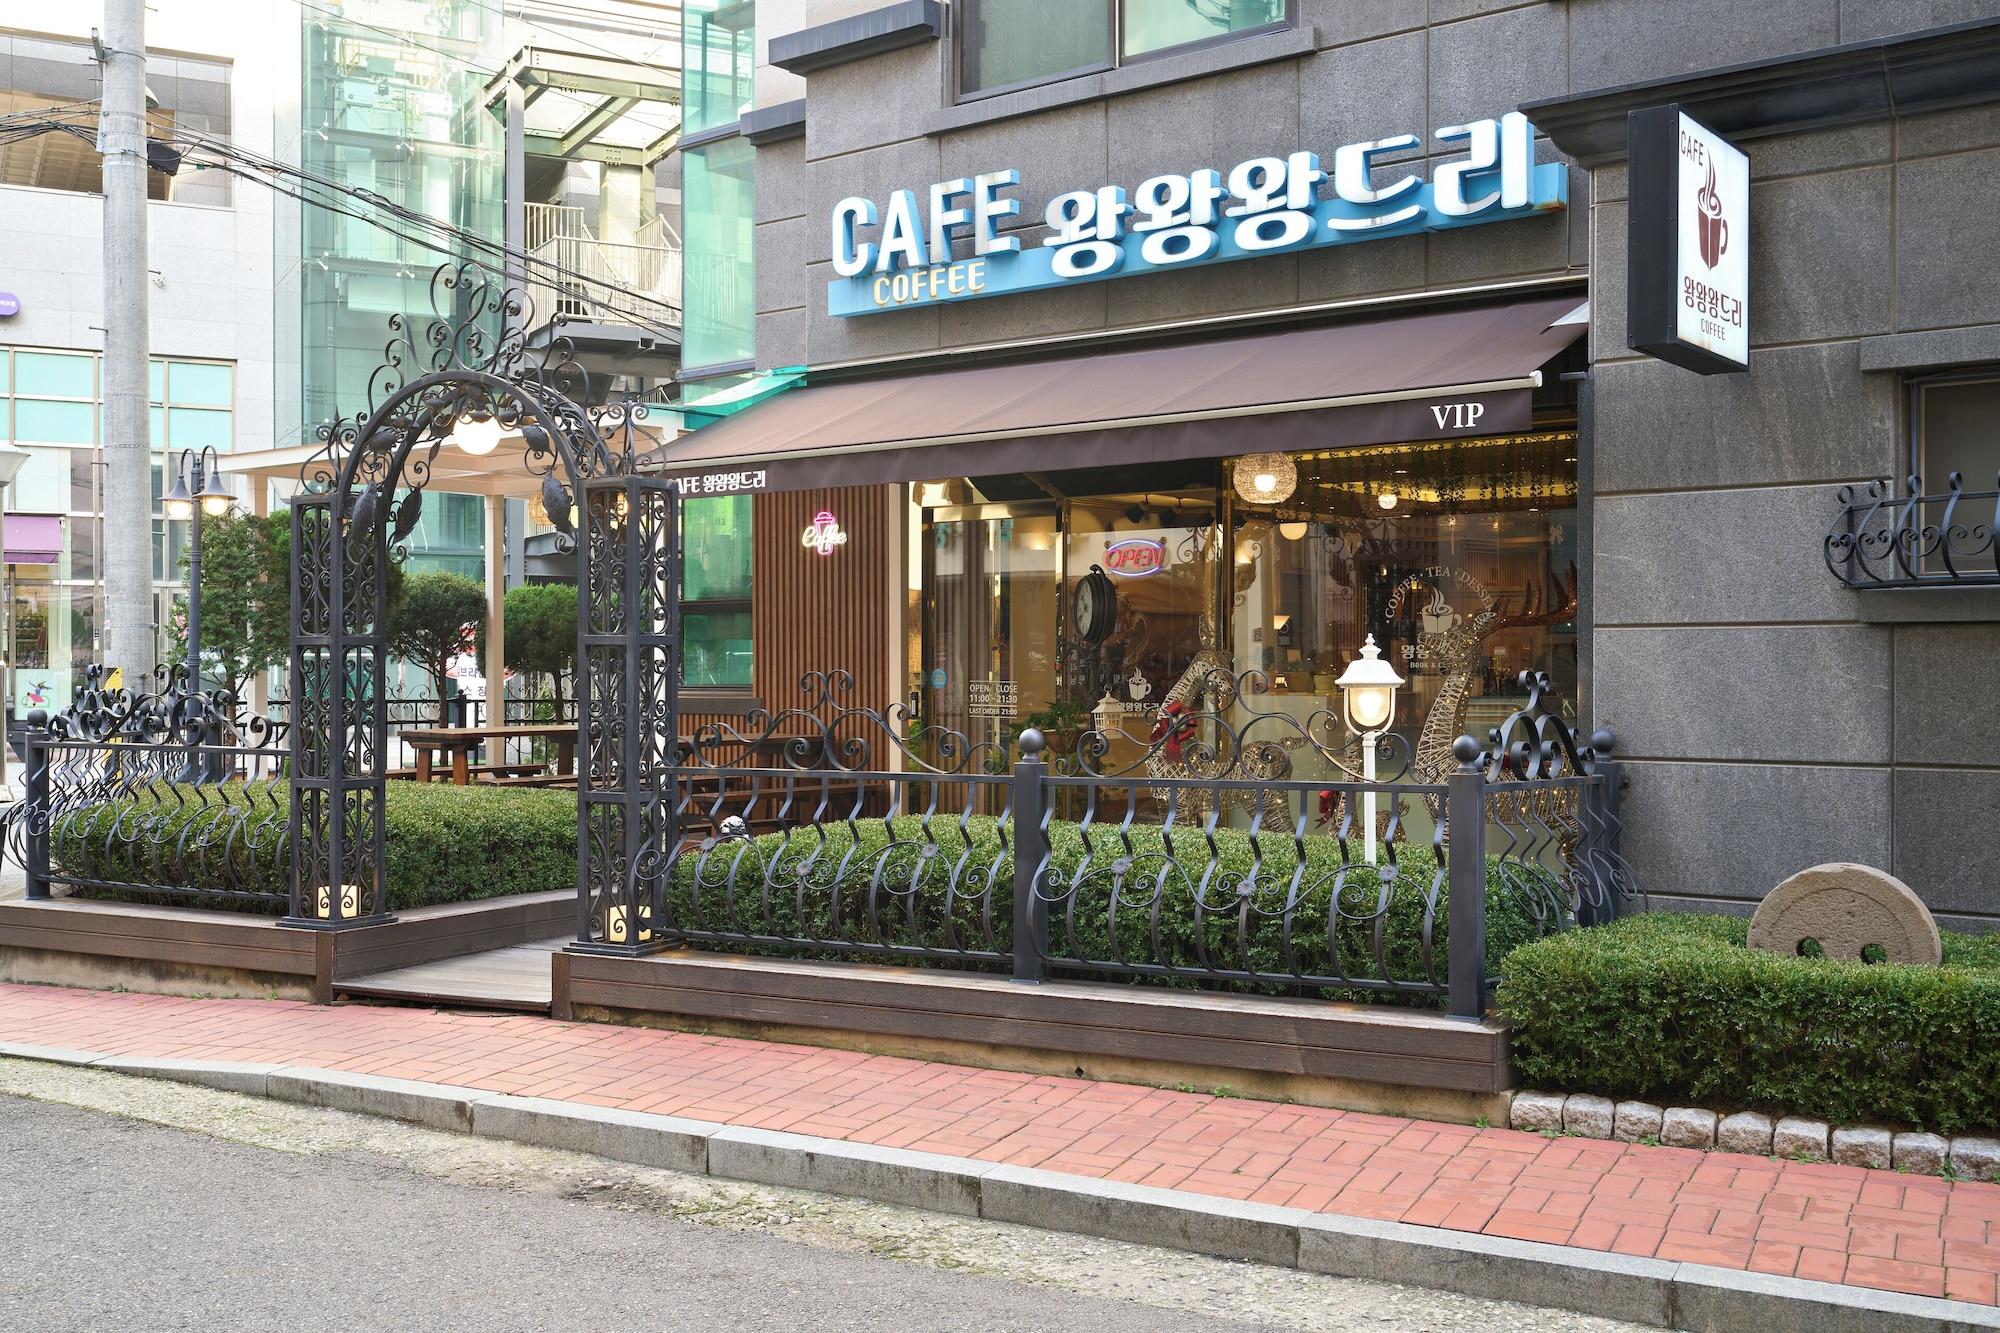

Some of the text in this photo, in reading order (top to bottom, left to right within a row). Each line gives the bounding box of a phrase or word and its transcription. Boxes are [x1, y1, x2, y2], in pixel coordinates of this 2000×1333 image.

[1680, 130, 1704, 168] CAFE
[832, 110, 1535, 278] CAFE 왕왕왕드리
[873, 261, 986, 306] COFFEE
[1683, 275, 1742, 329] 왕왕왕드리
[1700, 317, 1726, 342] COFFEE
[1430, 402, 1485, 430] VIP
[668, 470, 766, 495] AFE 왕왕왕드리
[1103, 546, 1164, 569] OPEN
[1385, 565, 1495, 619] COFFEE TEA DESSE
[1410, 661, 1429, 669] BOOK
[969, 684, 1018, 693] OPEN CLOSE
[969, 694, 990, 702] 11:00
[996, 695, 1018, 703] 21:30
